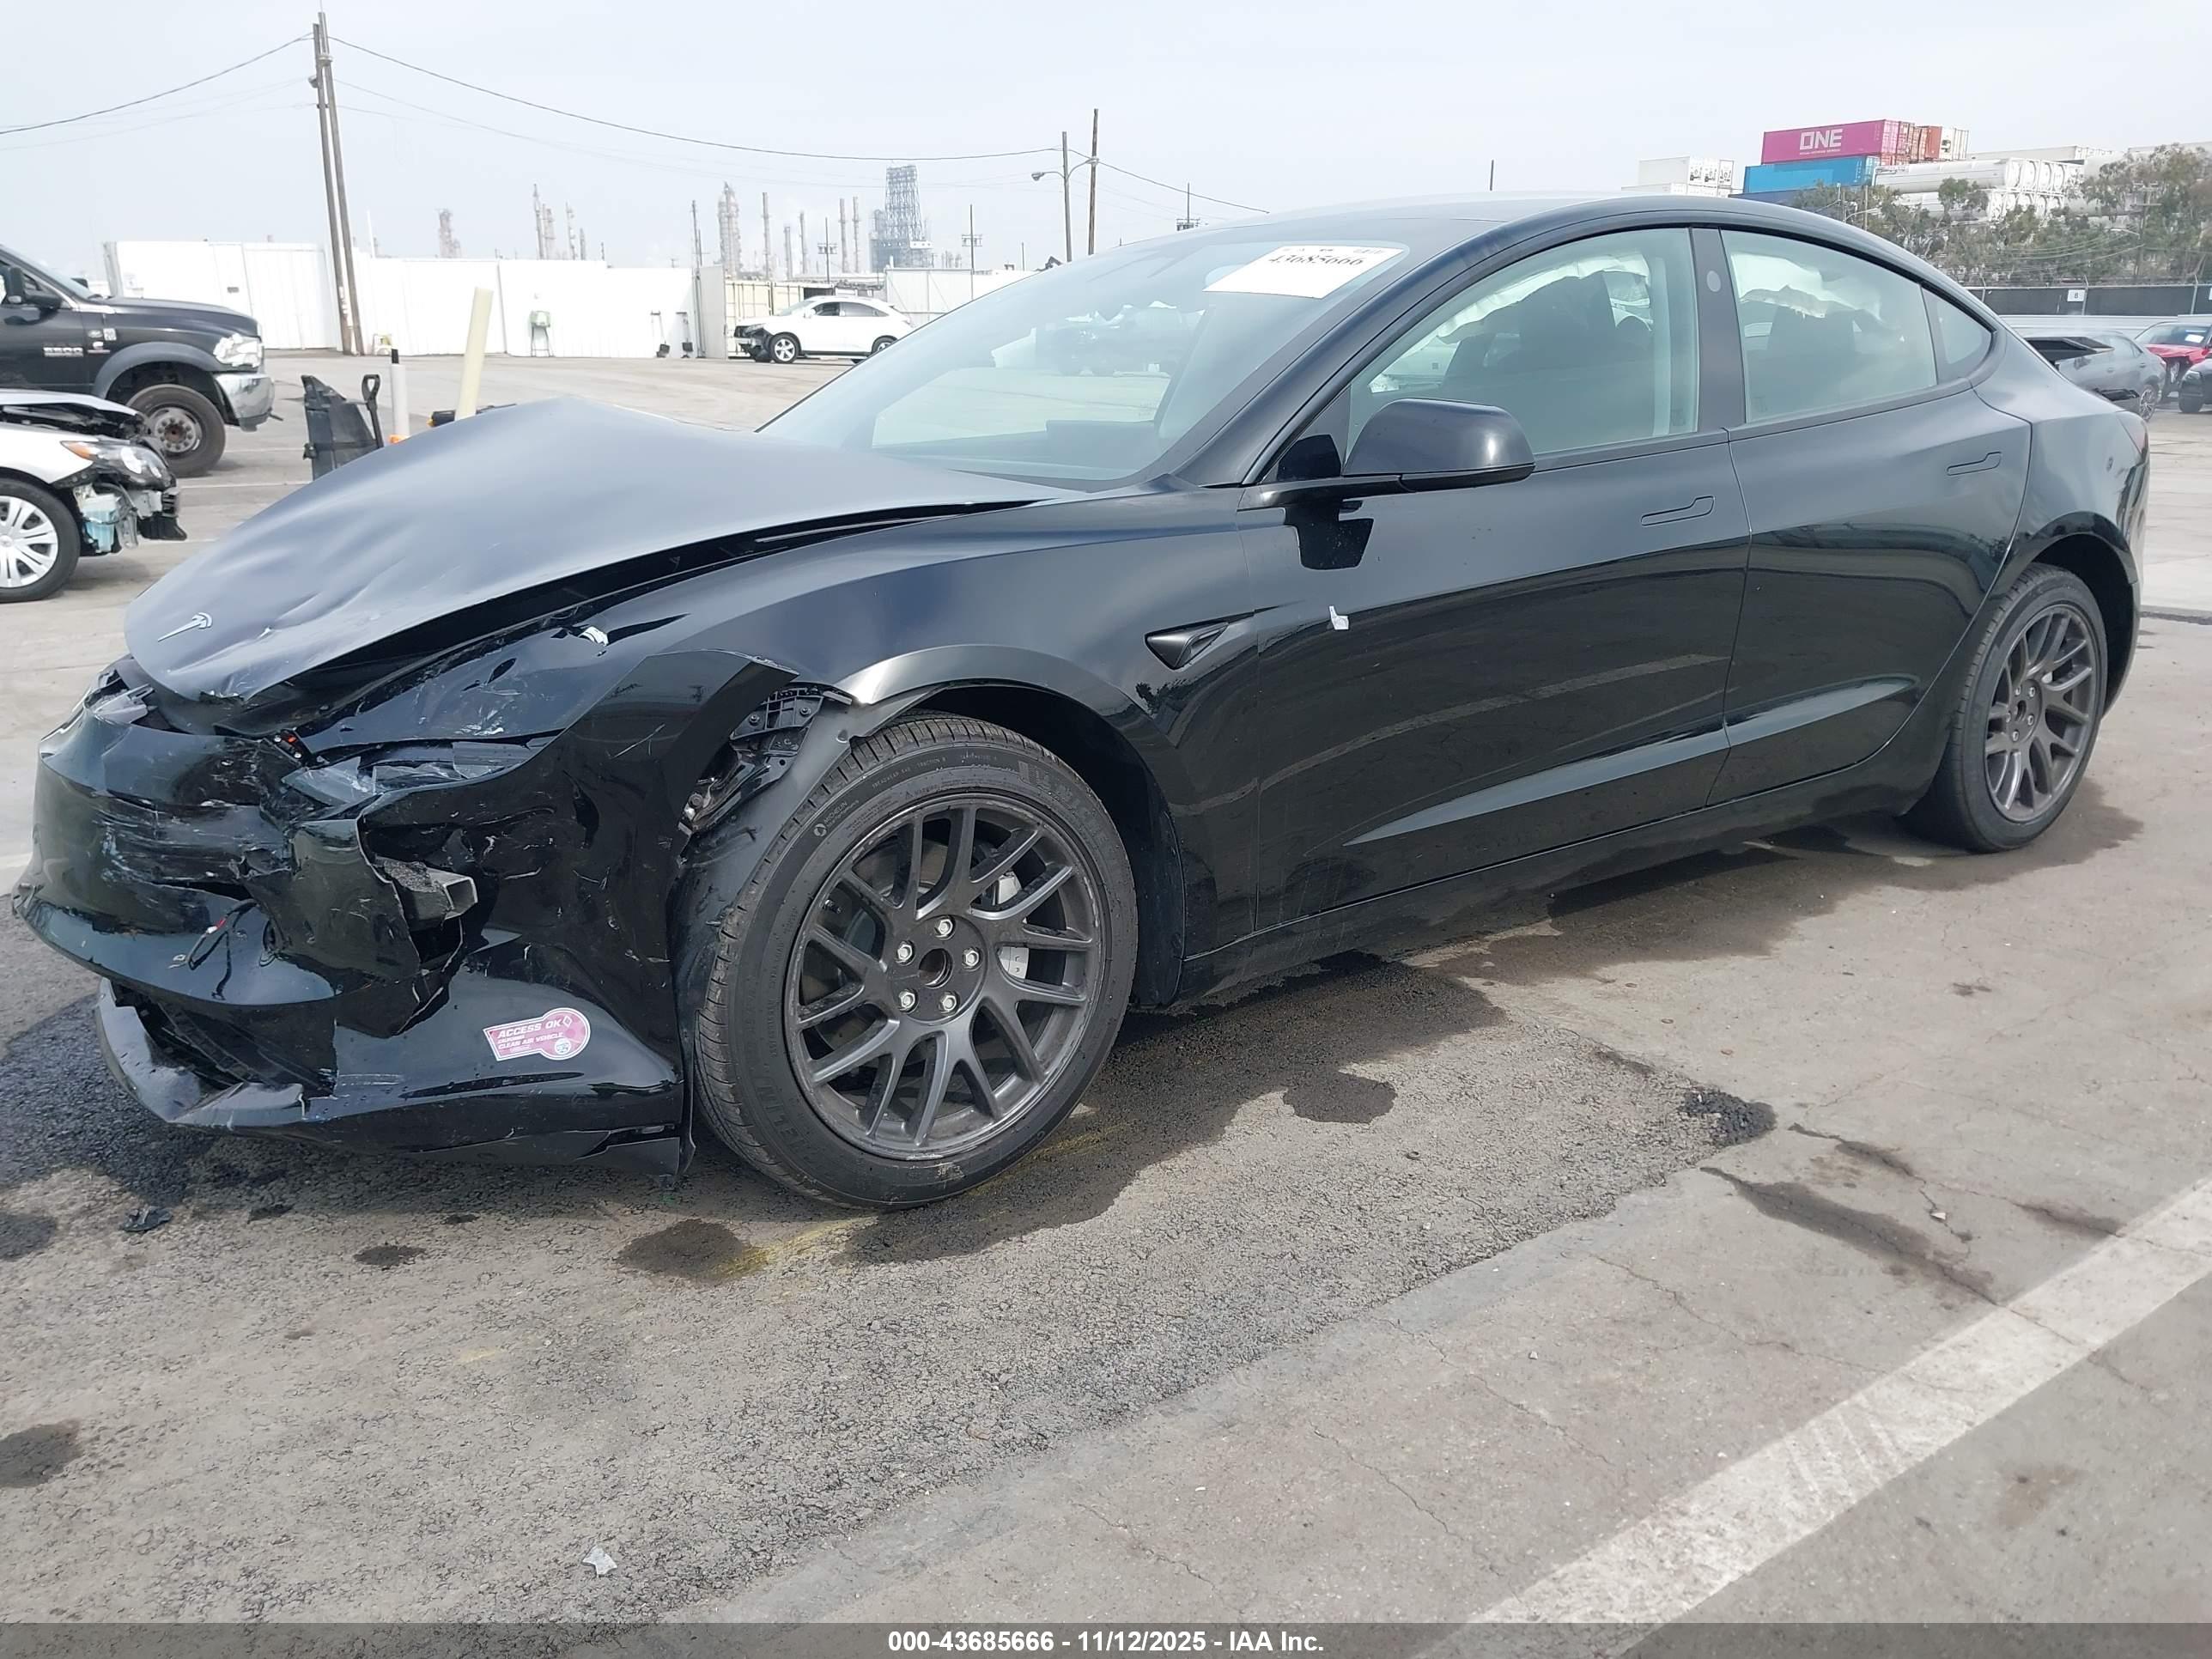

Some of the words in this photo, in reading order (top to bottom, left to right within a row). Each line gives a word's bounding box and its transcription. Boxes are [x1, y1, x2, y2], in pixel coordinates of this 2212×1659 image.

[1800, 129, 1843, 149] ONE
[497, 1023, 542, 1039] ACCESS
[545, 1018, 562, 1030] OK
[498, 1041, 520, 1049] CLEAN
[536, 1032, 563, 1042] VEHICLE
